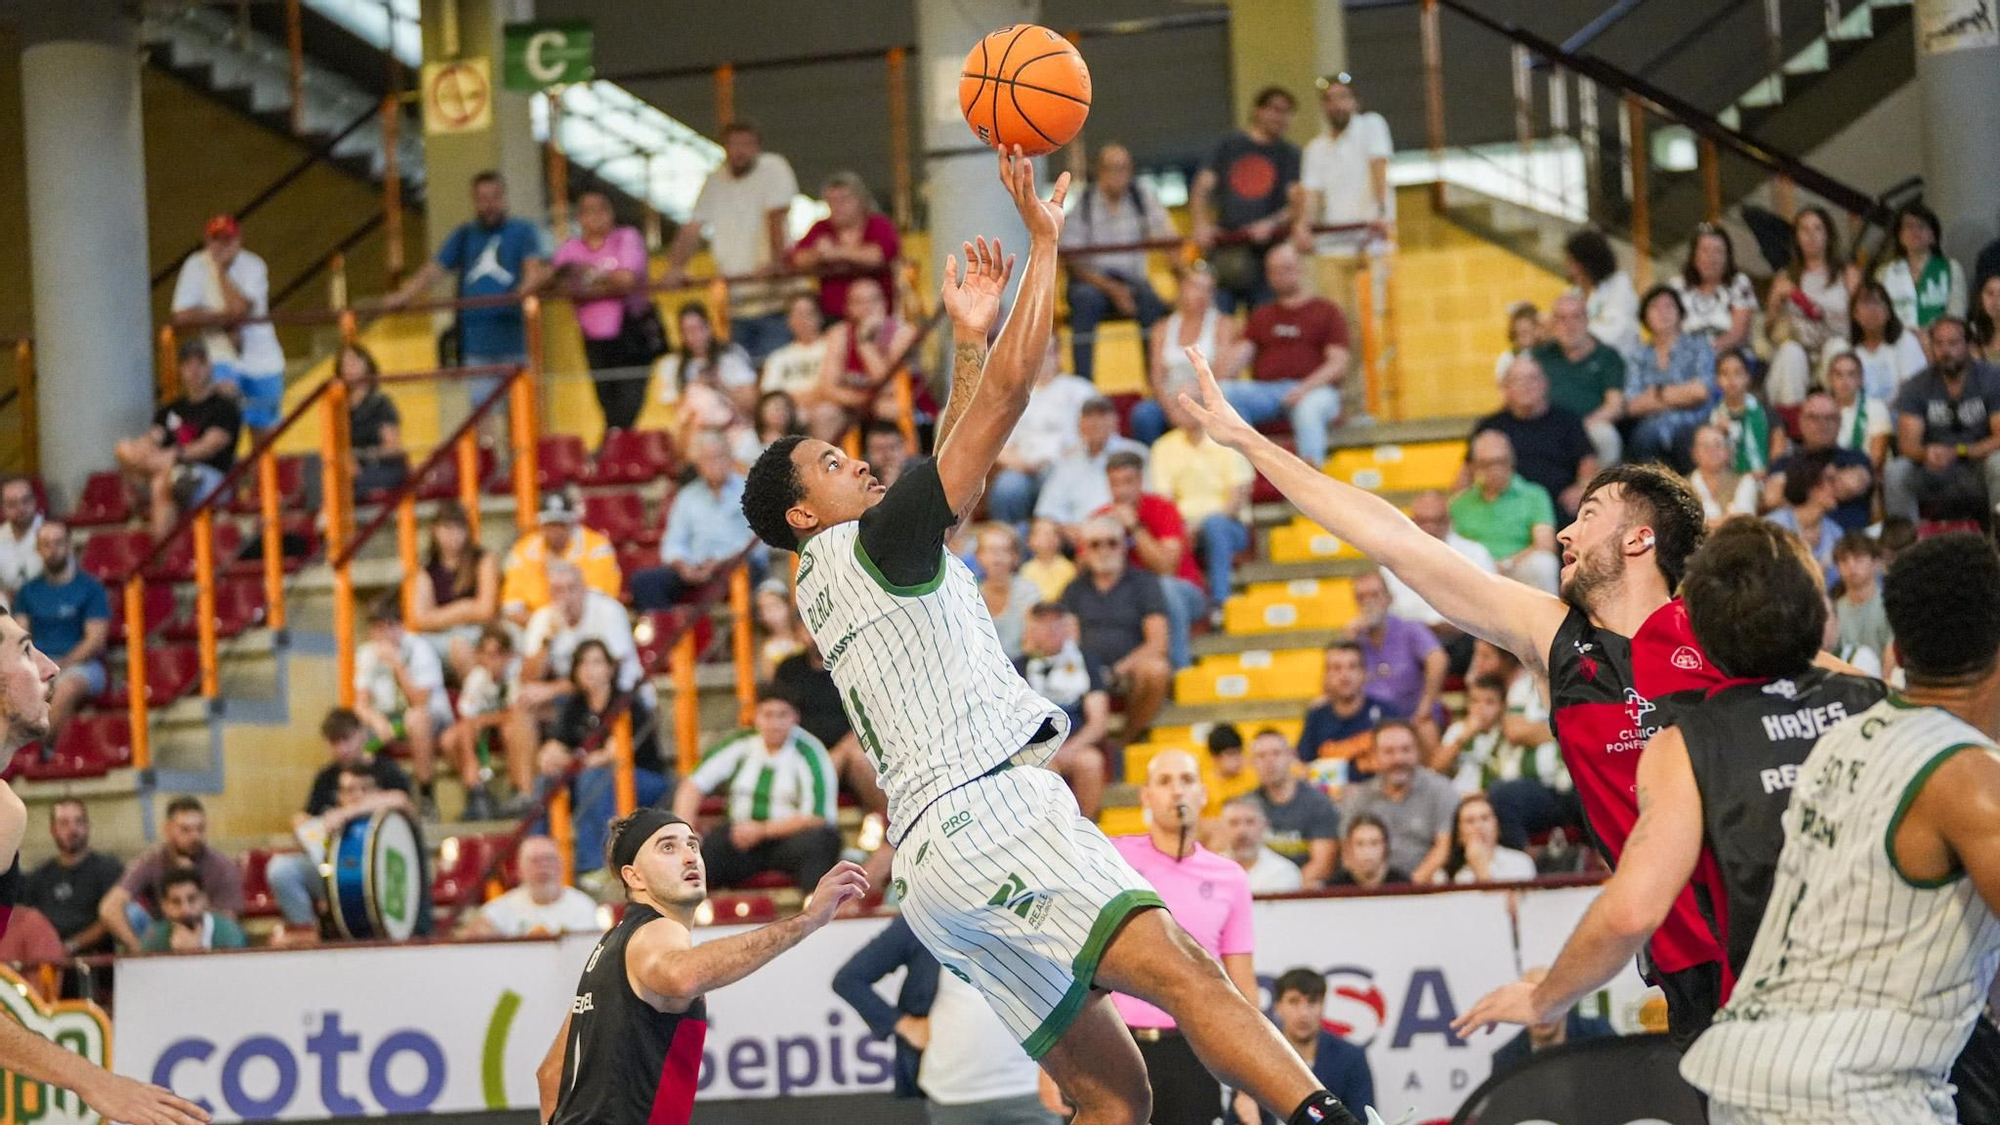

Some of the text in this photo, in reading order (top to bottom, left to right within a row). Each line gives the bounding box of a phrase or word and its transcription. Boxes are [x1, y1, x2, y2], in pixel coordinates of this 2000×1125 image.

[525, 30, 568, 81] C
[806, 583, 835, 635] BLACK
[1761, 701, 1848, 742] HAYES
[1760, 763, 1802, 795] RE
[941, 810, 972, 835] PRO
[1028, 892, 1049, 928] REALE
[150, 1009, 447, 1114] coto
